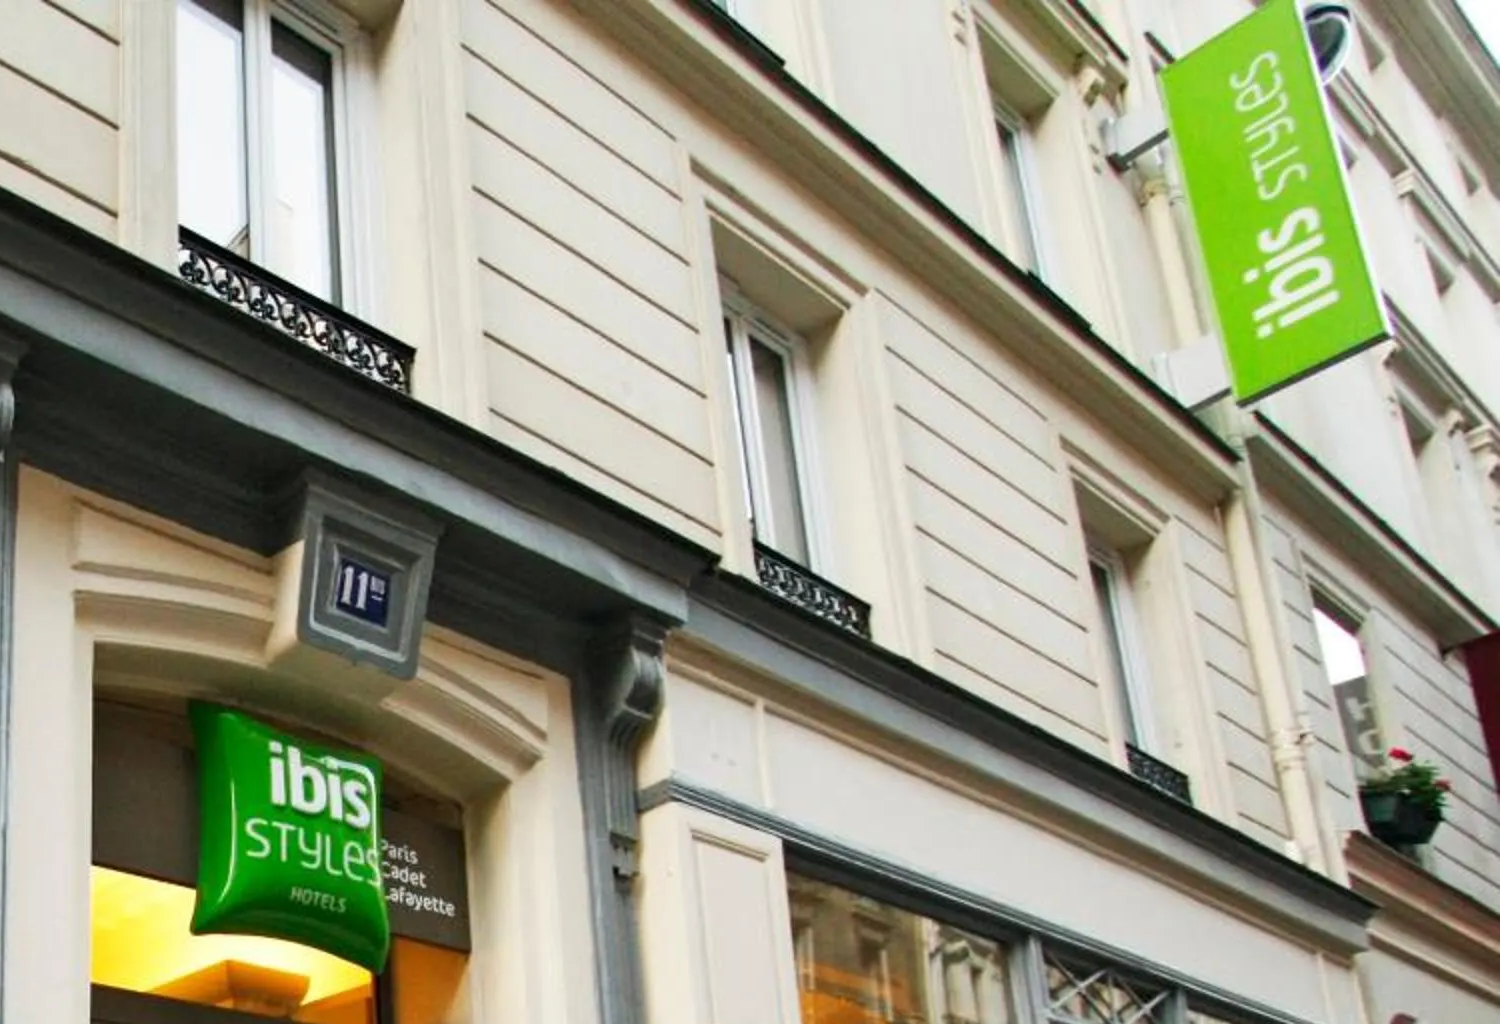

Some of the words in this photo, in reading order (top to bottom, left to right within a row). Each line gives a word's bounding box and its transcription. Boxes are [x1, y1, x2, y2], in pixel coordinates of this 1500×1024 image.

[1243, 206, 1340, 339] ibis
[269, 740, 372, 829] ibis
[290, 886, 347, 914] HOTELS
